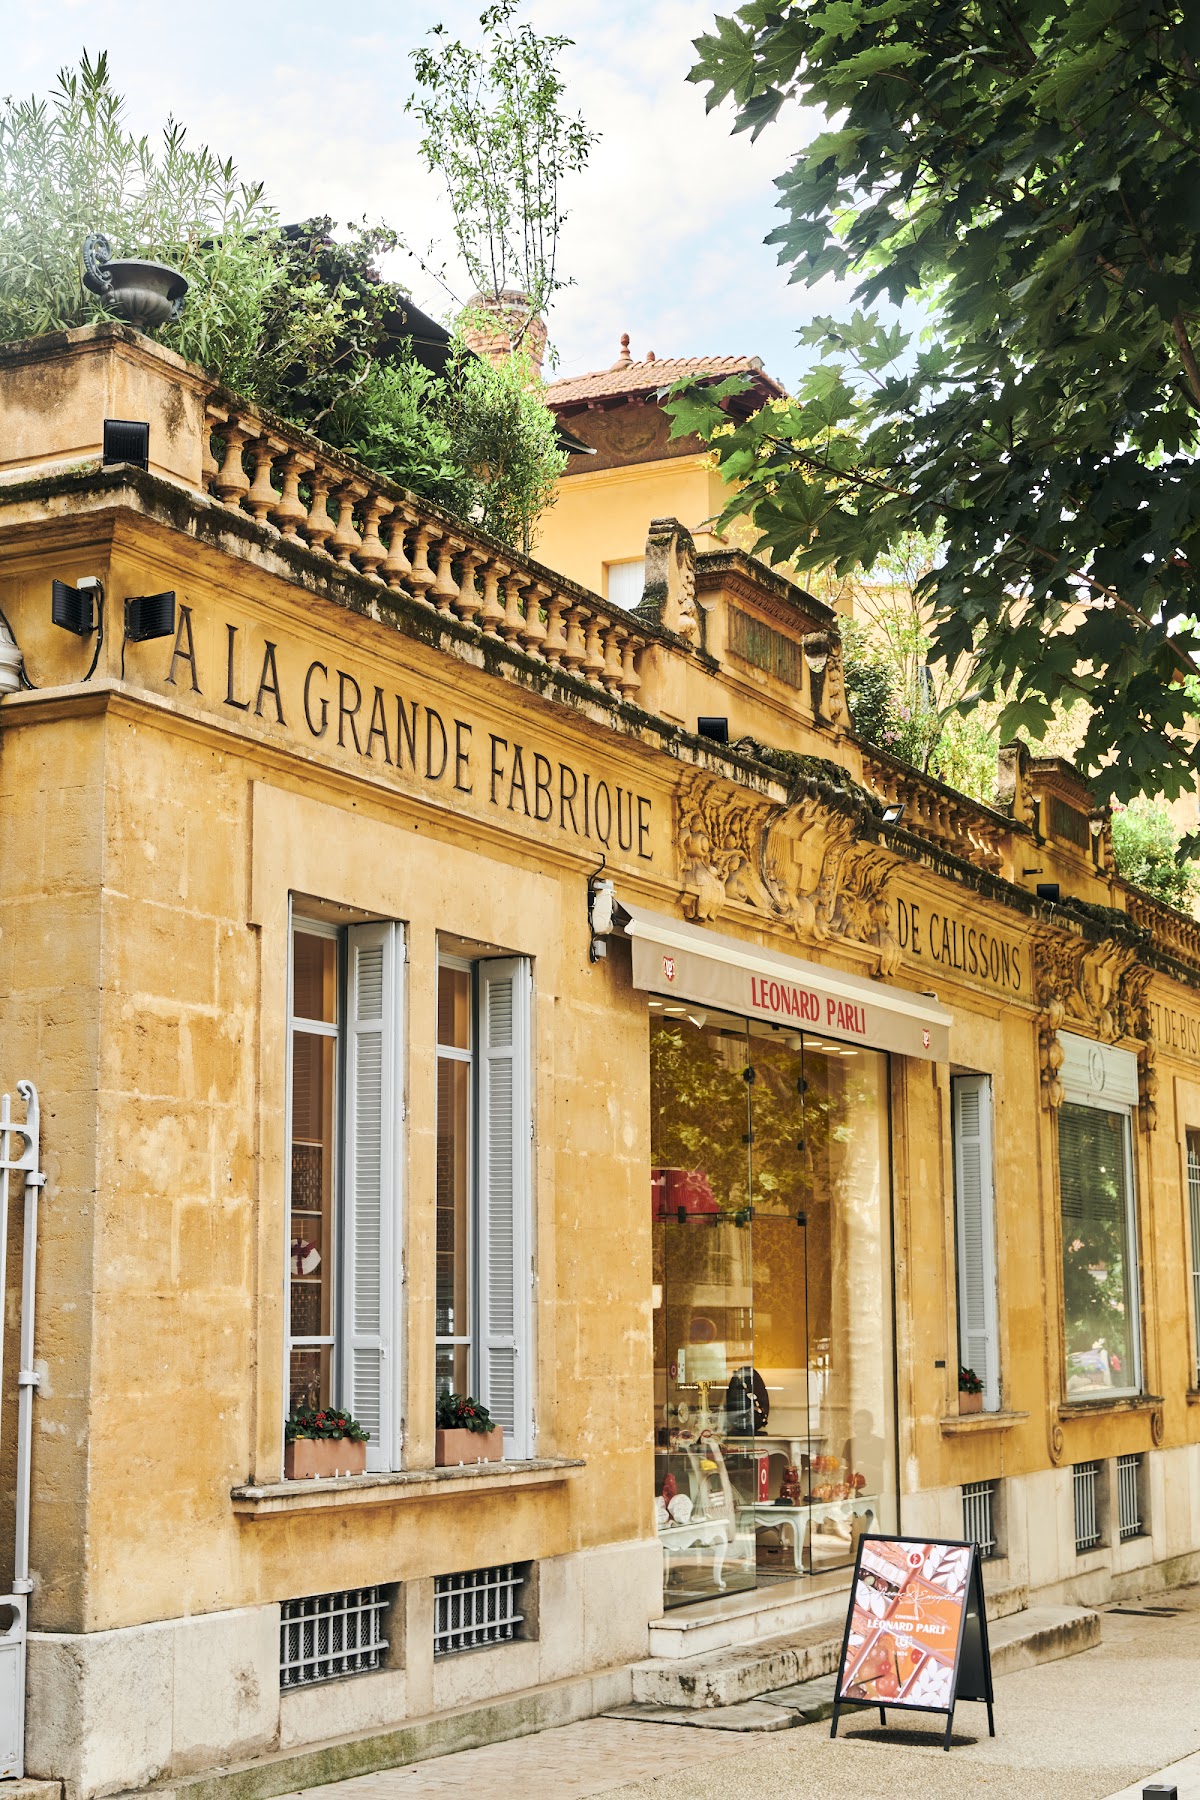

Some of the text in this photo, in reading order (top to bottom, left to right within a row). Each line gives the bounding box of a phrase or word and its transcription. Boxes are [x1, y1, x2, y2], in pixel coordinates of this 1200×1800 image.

[164, 603, 654, 861] A LA GRANDE FABRIQUE
[896, 897, 1021, 991] DE CALISSONS
[751, 976, 866, 1034] LEONARD PARLI
[1164, 1007, 1178, 1048] DE
[867, 1618, 914, 1632] LÉONARD
[915, 1623, 946, 1635] PARLI
